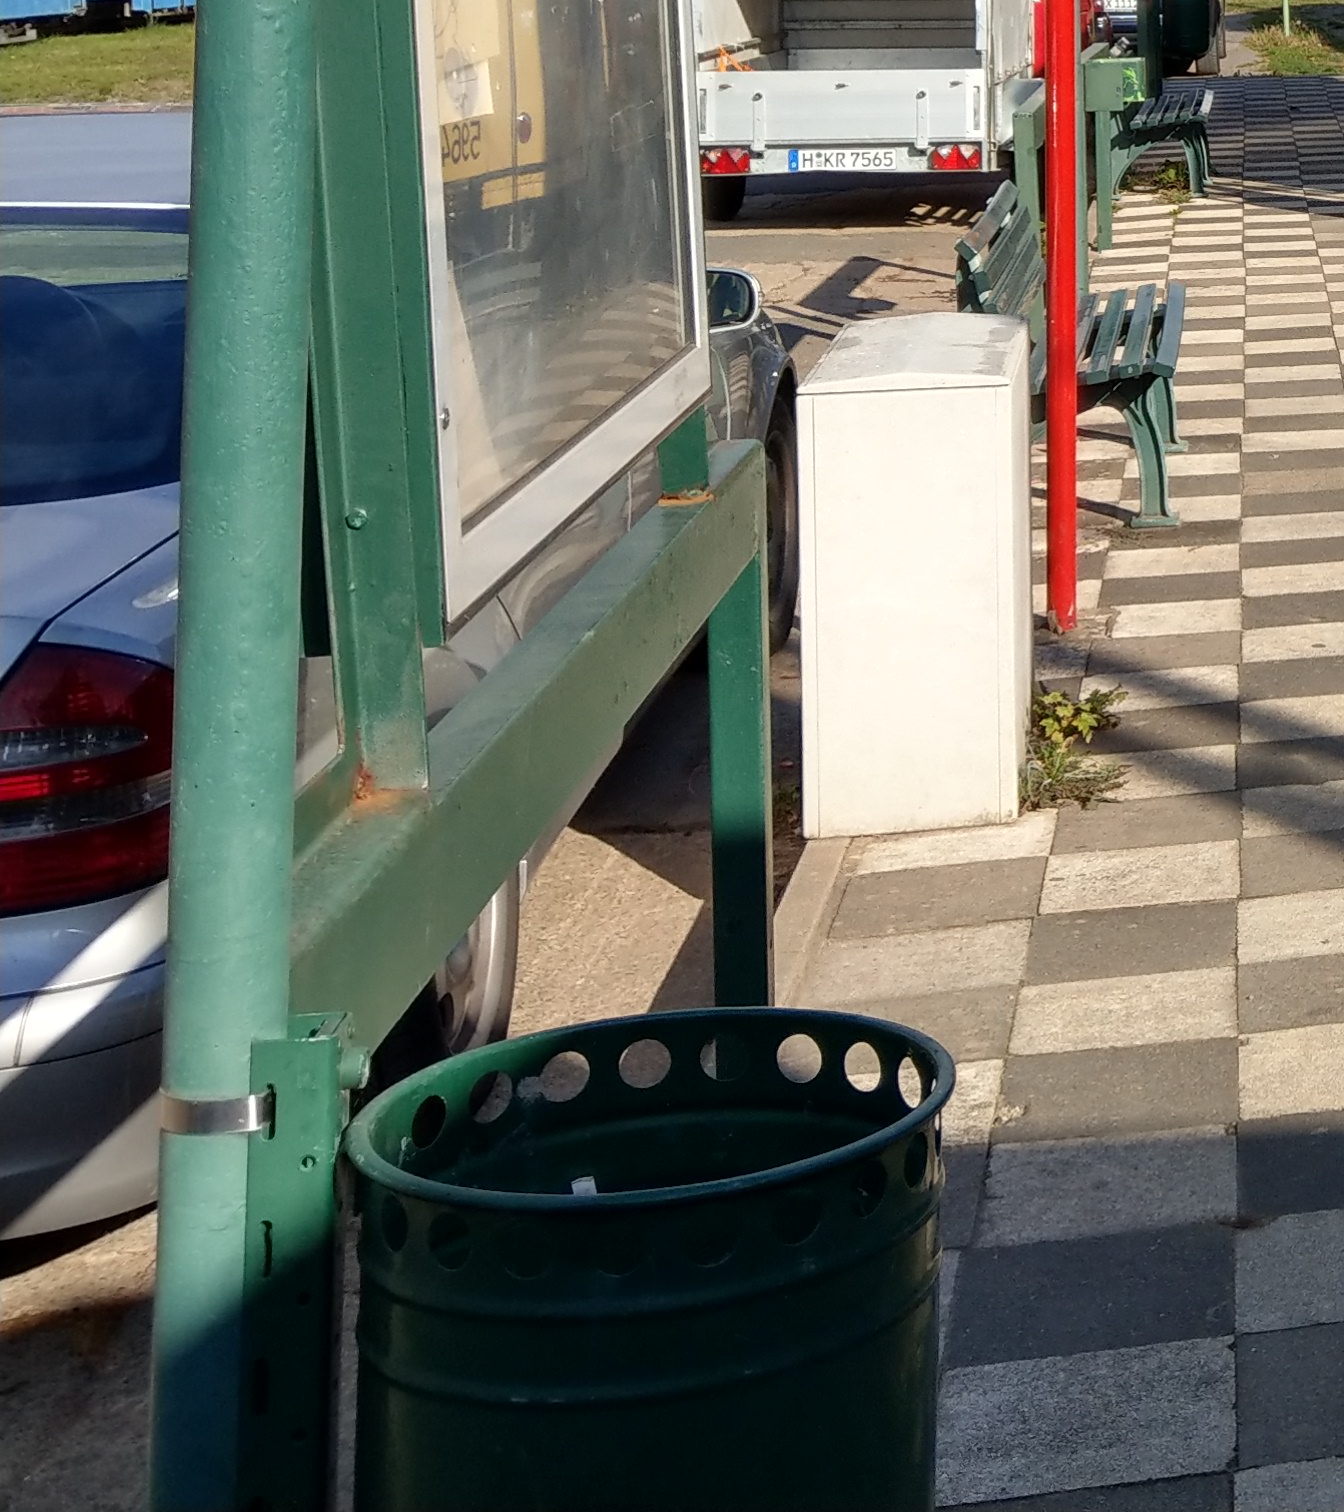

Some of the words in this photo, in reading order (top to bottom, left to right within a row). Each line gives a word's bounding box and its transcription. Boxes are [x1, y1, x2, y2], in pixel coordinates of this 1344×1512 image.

[802, 152, 814, 169] H
[824, 152, 846, 168] KR
[850, 151, 894, 168] 7565
